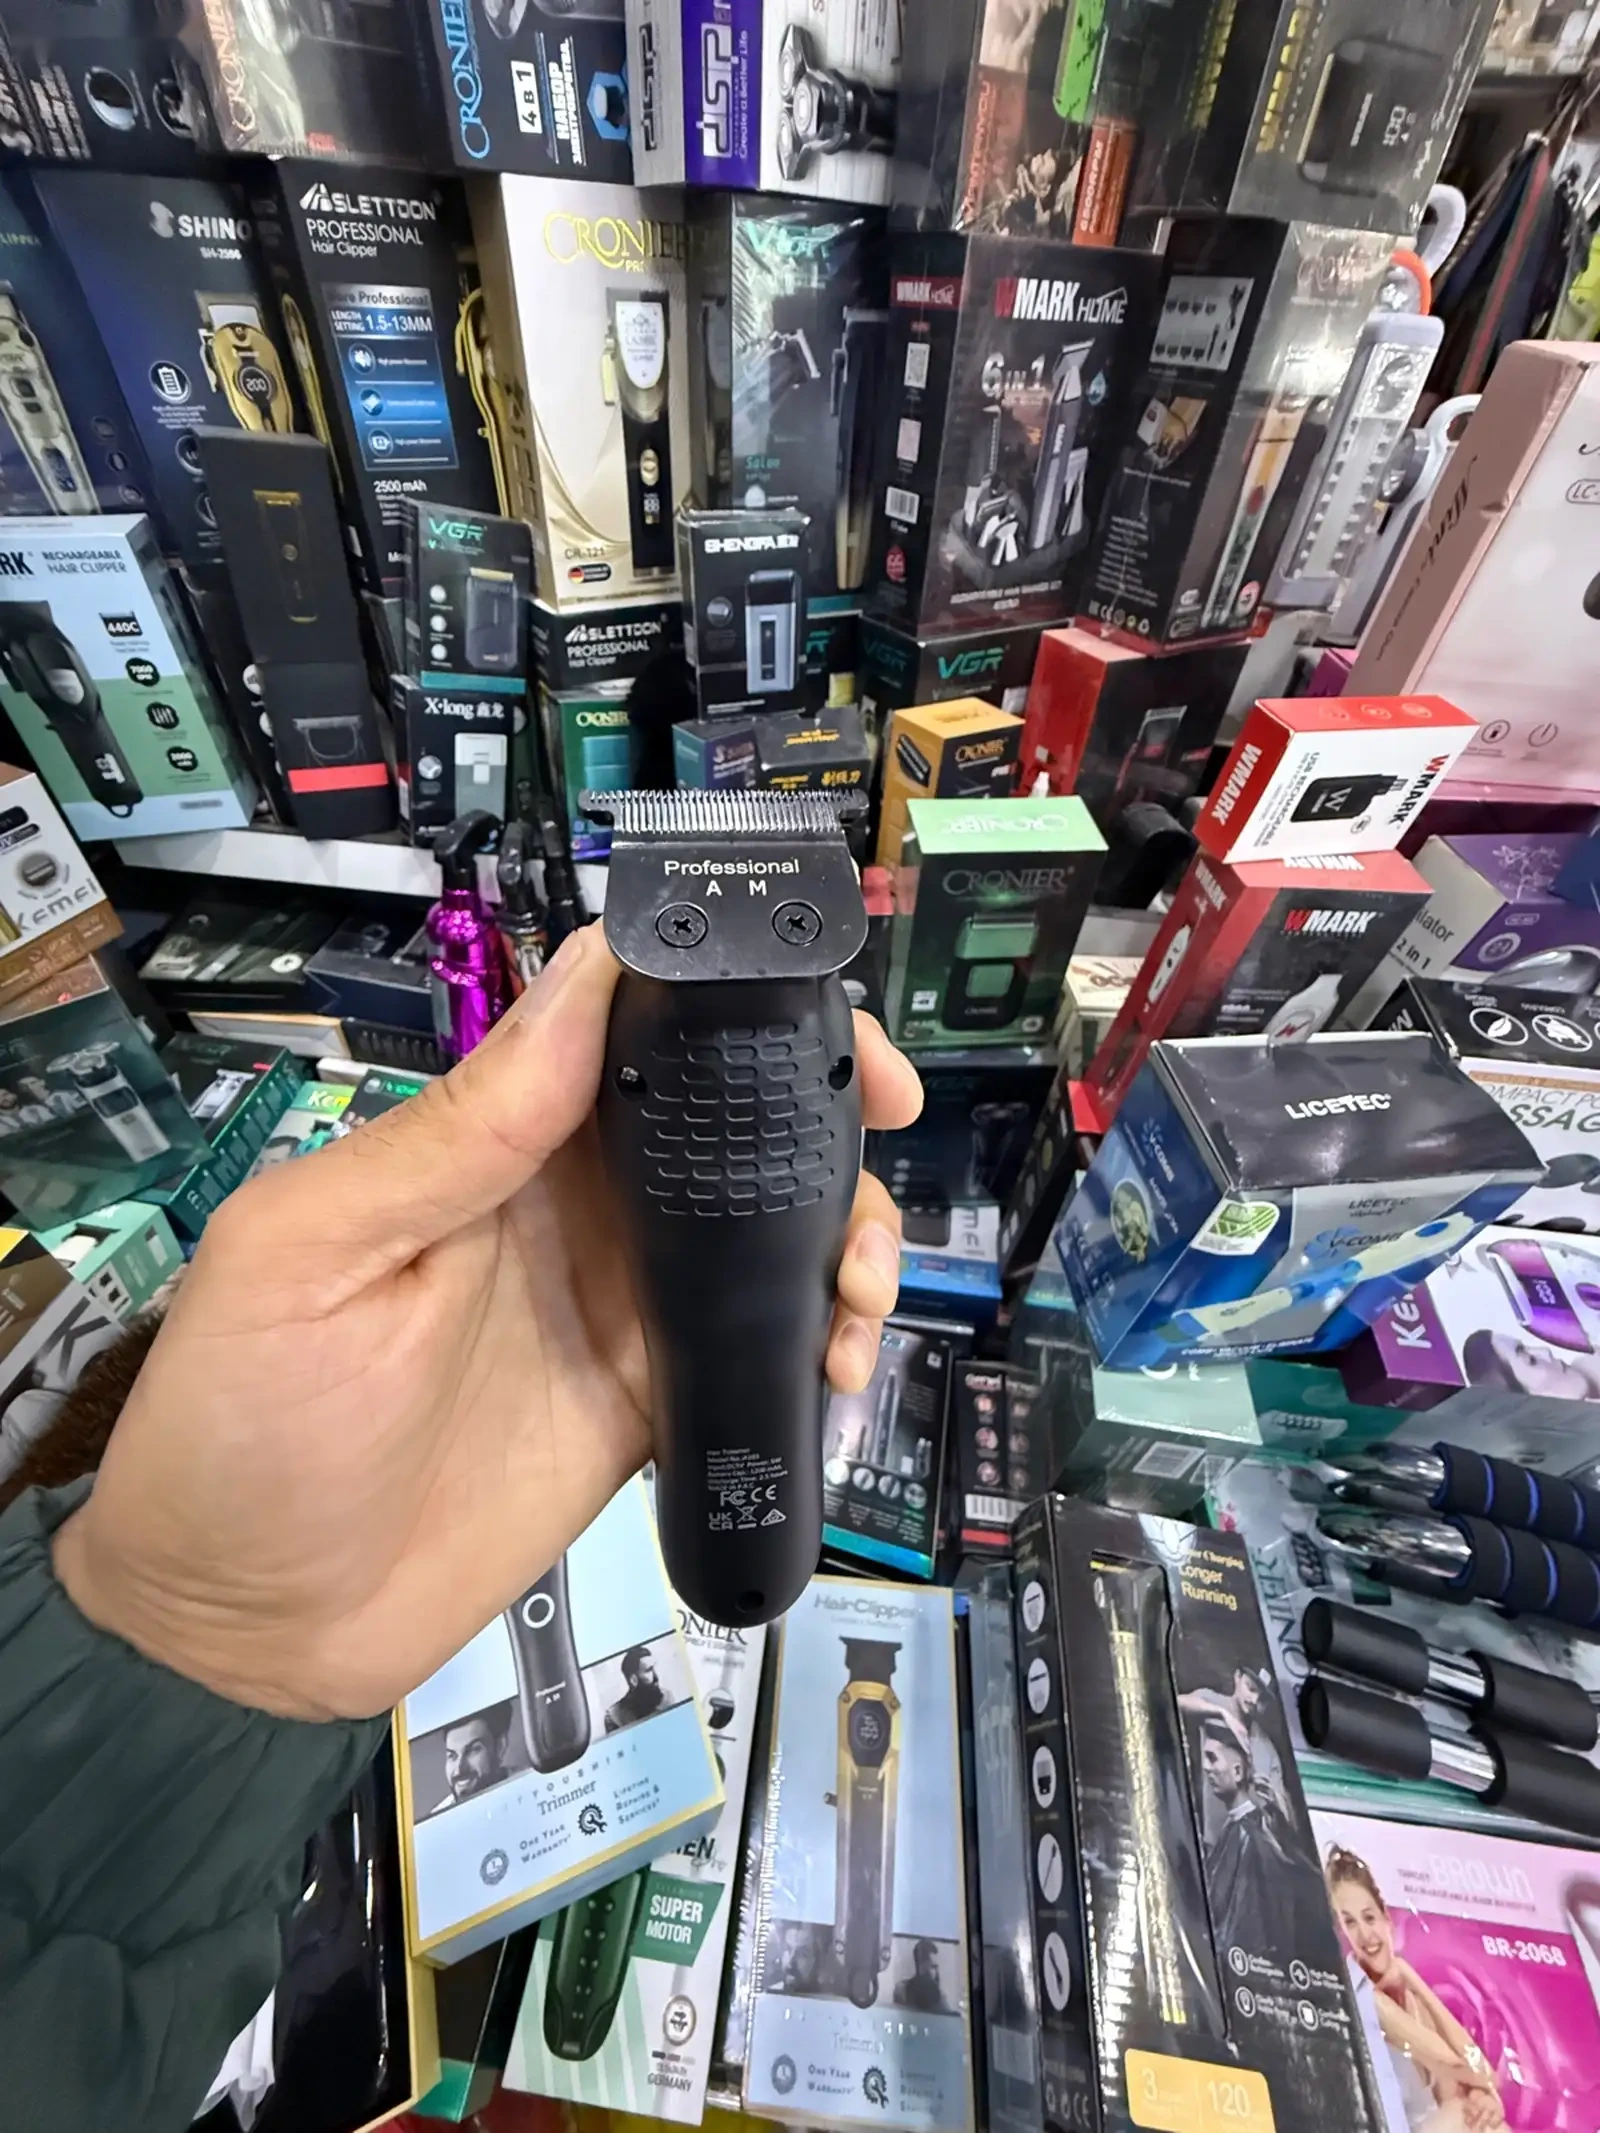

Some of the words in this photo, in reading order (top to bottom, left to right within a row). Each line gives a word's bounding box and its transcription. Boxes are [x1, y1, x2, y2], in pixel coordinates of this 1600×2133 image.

[440, 0, 490, 158] CRONIE
[306, 217, 424, 245] PROFESSIONAL
[311, 240, 335, 254] Hair
[336, 242, 378, 258] Clipper
[995, 277, 1081, 324] WMARK
[1077, 290, 1128, 324] HOME
[365, 313, 433, 333] 1.5-13MM
[981, 353, 1004, 398] 6
[1030, 355, 1046, 390] 1
[373, 480, 402, 493] 2500
[402, 479, 428, 492] mAh
[428, 518, 487, 541] VGR
[567, 640, 650, 658] PROFESSIONAL
[938, 647, 1004, 680] VGR
[1211, 743, 1262, 826] WMARK
[1389, 754, 1450, 824] WMARK
[664, 858, 800, 876] Professional
[942, 867, 1066, 895] CRONIER
[706, 879, 722, 896] A
[749, 879, 767, 896] M
[1283, 910, 1377, 934] WMARK
[1396, 938, 1407, 951] 2
[1406, 948, 1420, 962] in
[1421, 957, 1431, 970] 1
[1284, 1092, 1387, 1120] LICETEC
[1181, 1580, 1238, 1611] Running
[537, 1781, 596, 1815] Trimmer
[650, 1895, 704, 1924] SUPER
[646, 1920, 692, 1945] MOTOR
[1482, 1935, 1568, 1967] BR-2068
[647, 2073, 692, 2093] GERMANY
[1207, 2080, 1251, 2119] 120
